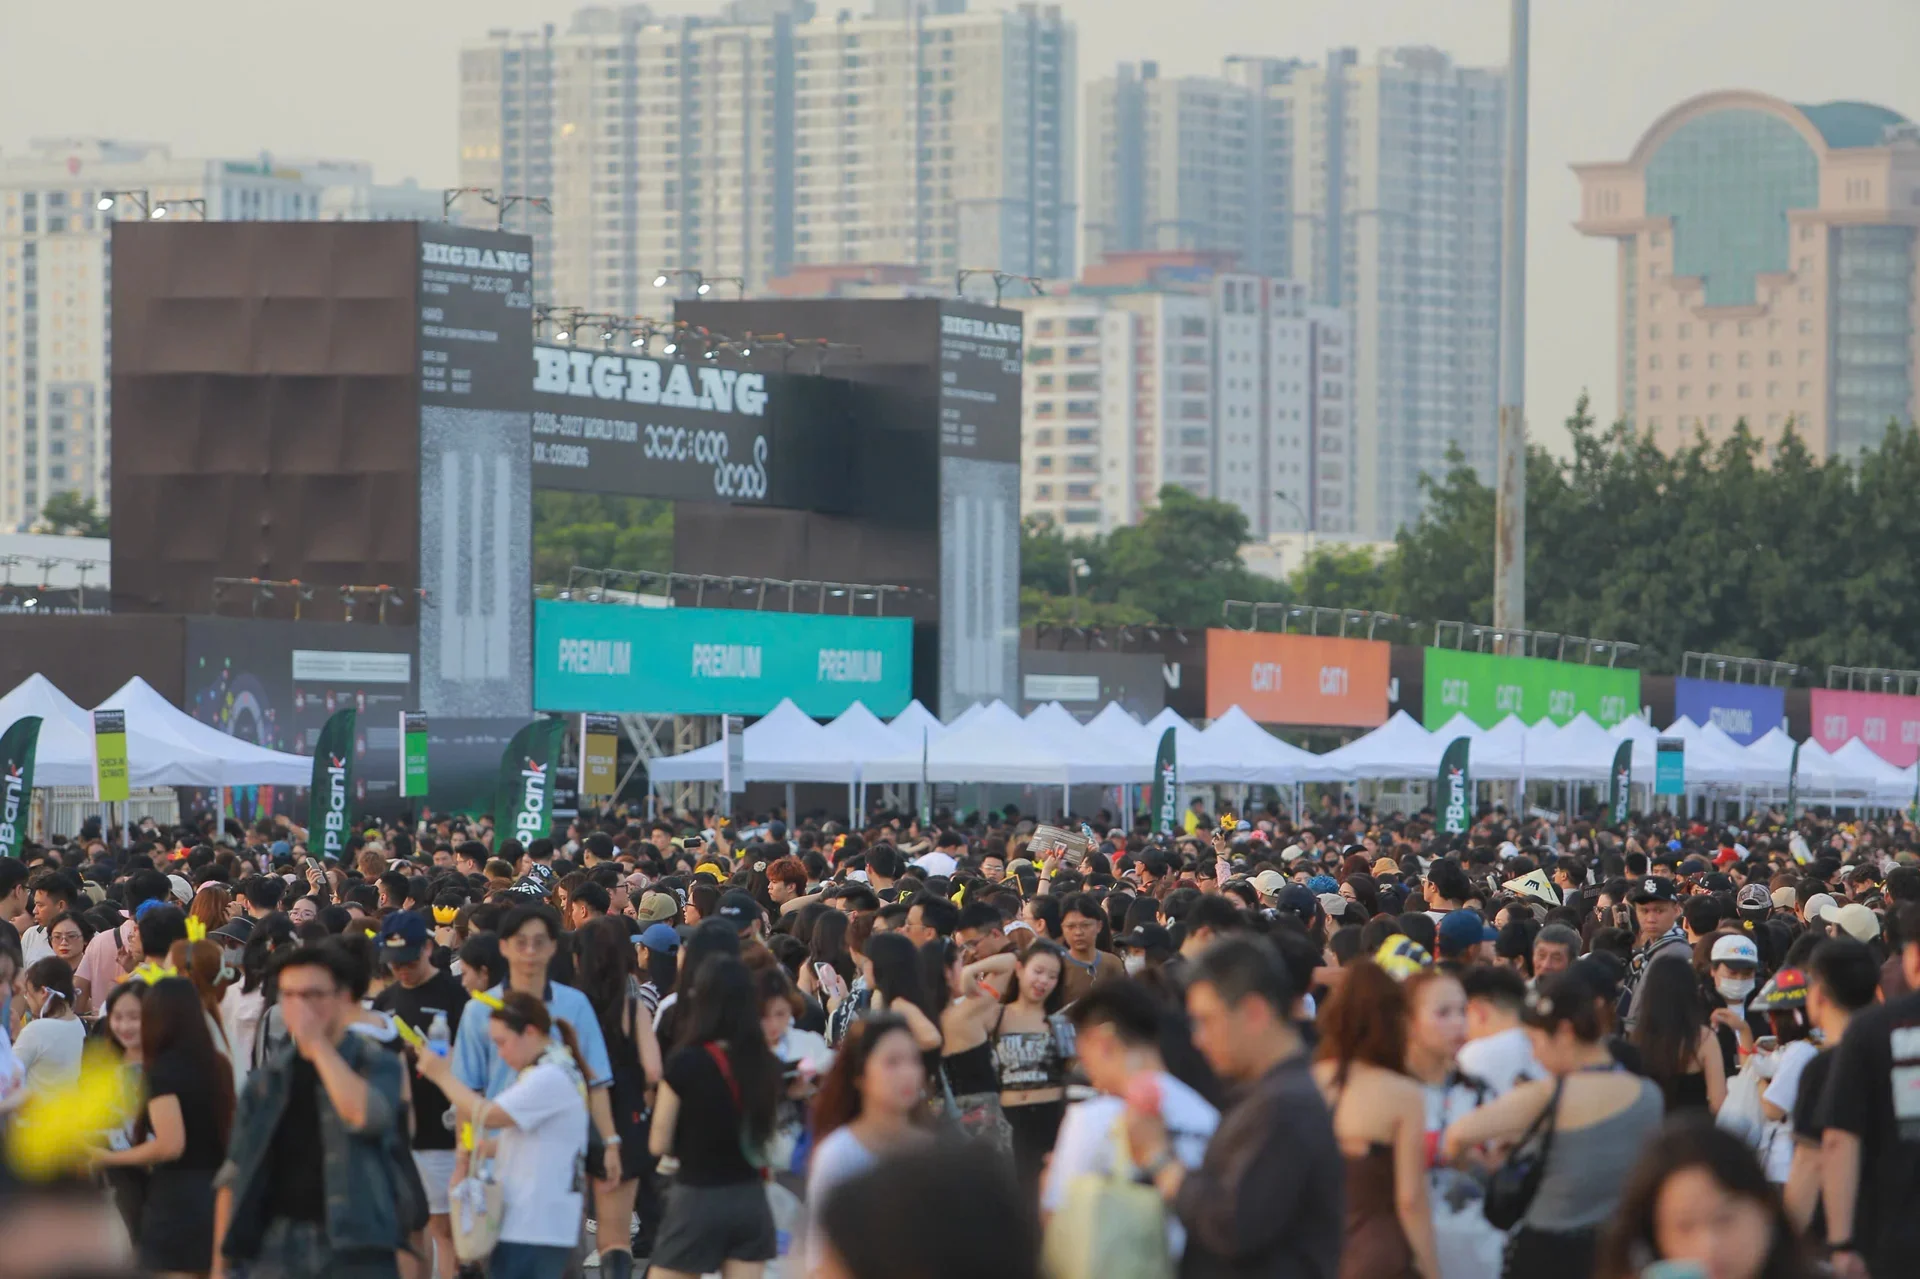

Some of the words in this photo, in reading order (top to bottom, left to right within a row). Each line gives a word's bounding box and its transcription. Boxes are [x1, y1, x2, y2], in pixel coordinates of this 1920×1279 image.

[422, 241, 532, 273] BIGBANG
[941, 315, 1021, 343] BIGBANG
[533, 346, 768, 416] BIGBANG
[558, 638, 632, 675] PREMIUM
[691, 643, 762, 679] PREMIUM
[817, 649, 883, 683] PREMIUM
